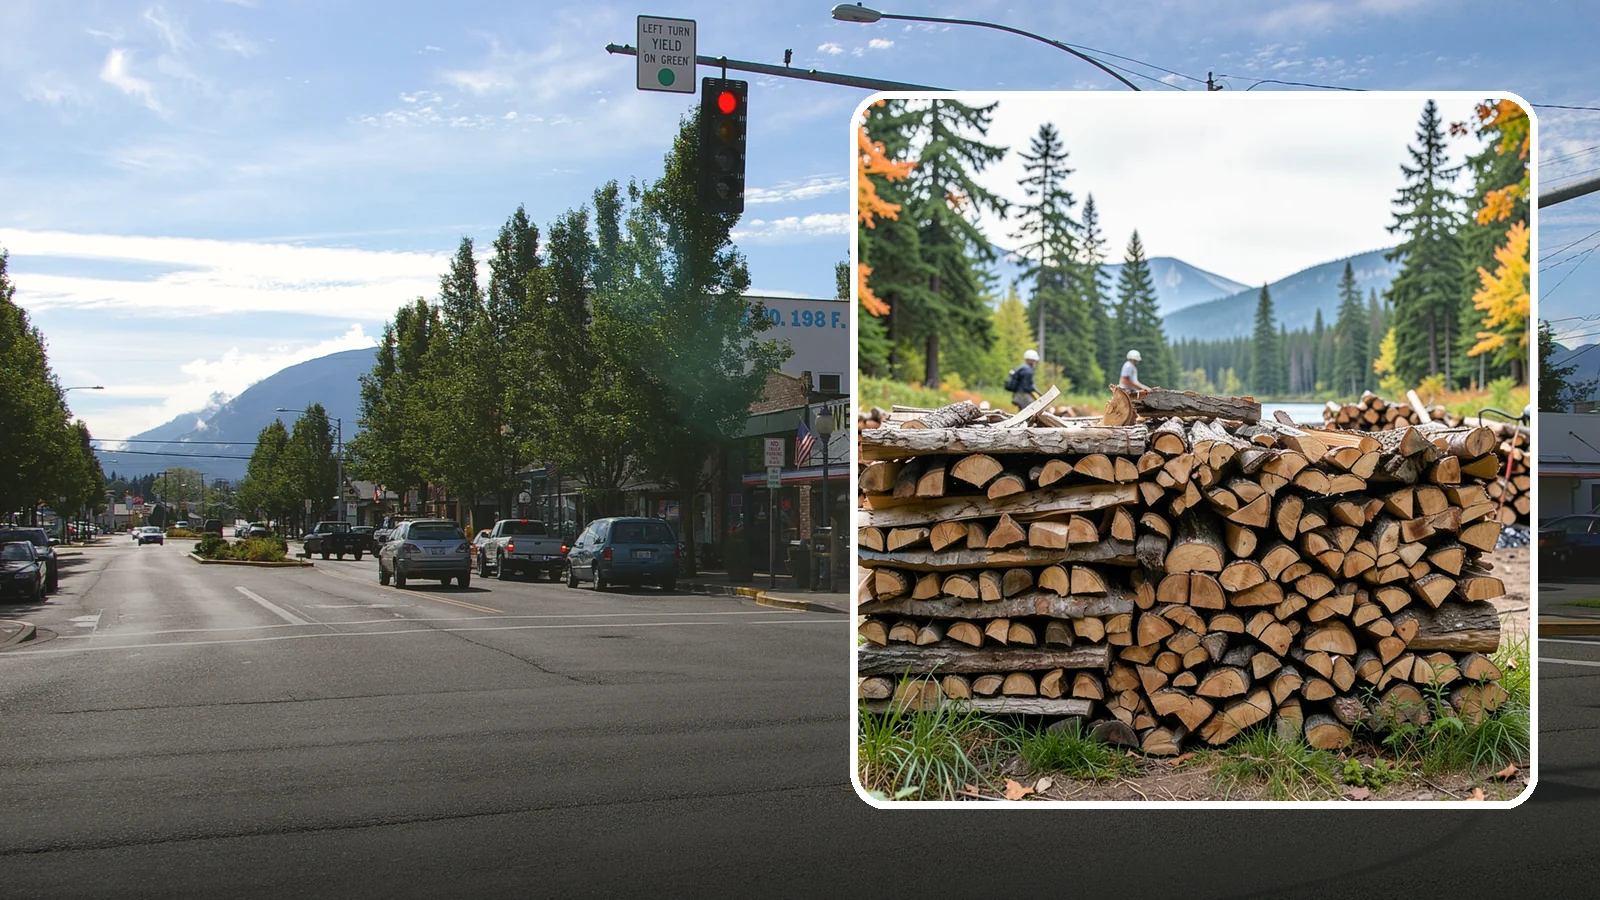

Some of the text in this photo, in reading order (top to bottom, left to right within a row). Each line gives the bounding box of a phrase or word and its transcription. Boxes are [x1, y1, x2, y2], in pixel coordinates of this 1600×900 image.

[643, 23, 690, 37] LEFT TURN
[652, 37, 682, 52] YIELD
[644, 53, 689, 66] ON GREEN
[791, 309, 826, 328] 198
[831, 311, 846, 329] F.
